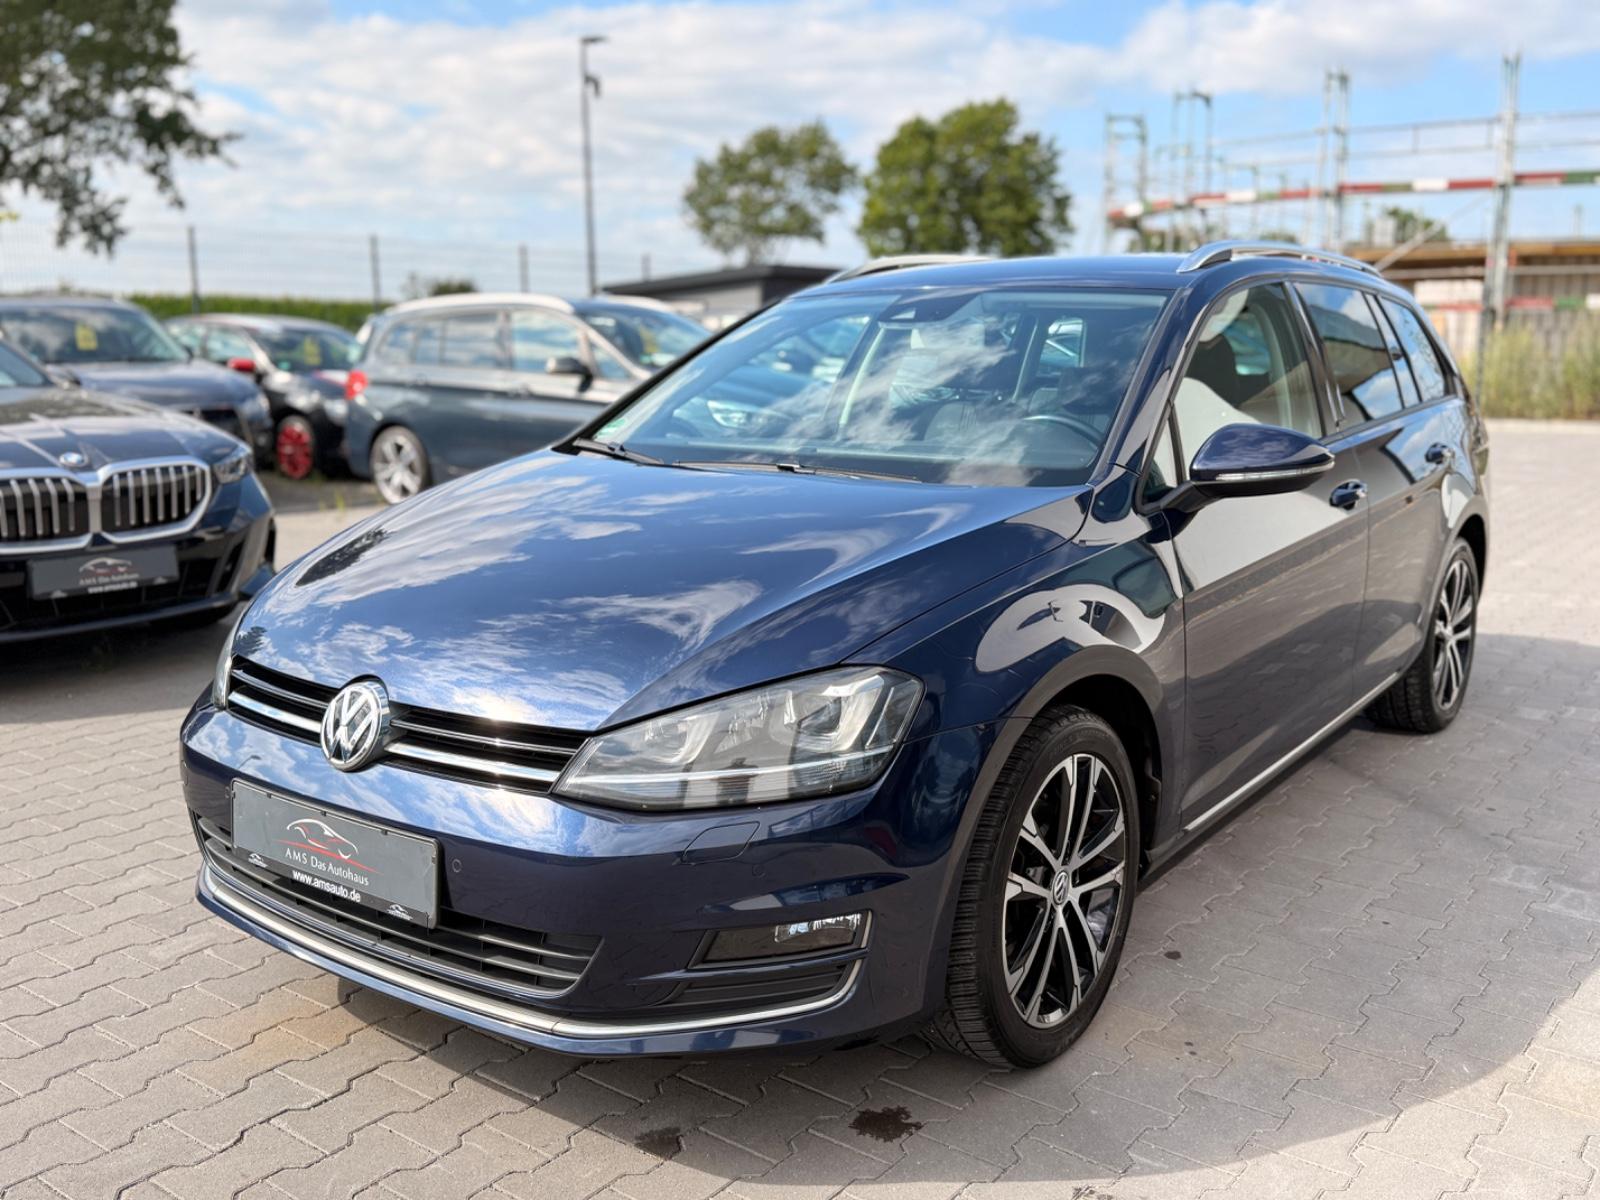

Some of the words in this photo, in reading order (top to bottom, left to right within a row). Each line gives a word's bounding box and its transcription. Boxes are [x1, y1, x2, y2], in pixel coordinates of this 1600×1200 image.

[324, 685, 380, 766] VW
[285, 847, 307, 865] AMS
[310, 856, 327, 871] Das
[328, 863, 369, 886] Autohaus
[292, 870, 361, 903] www.amsauto.de
